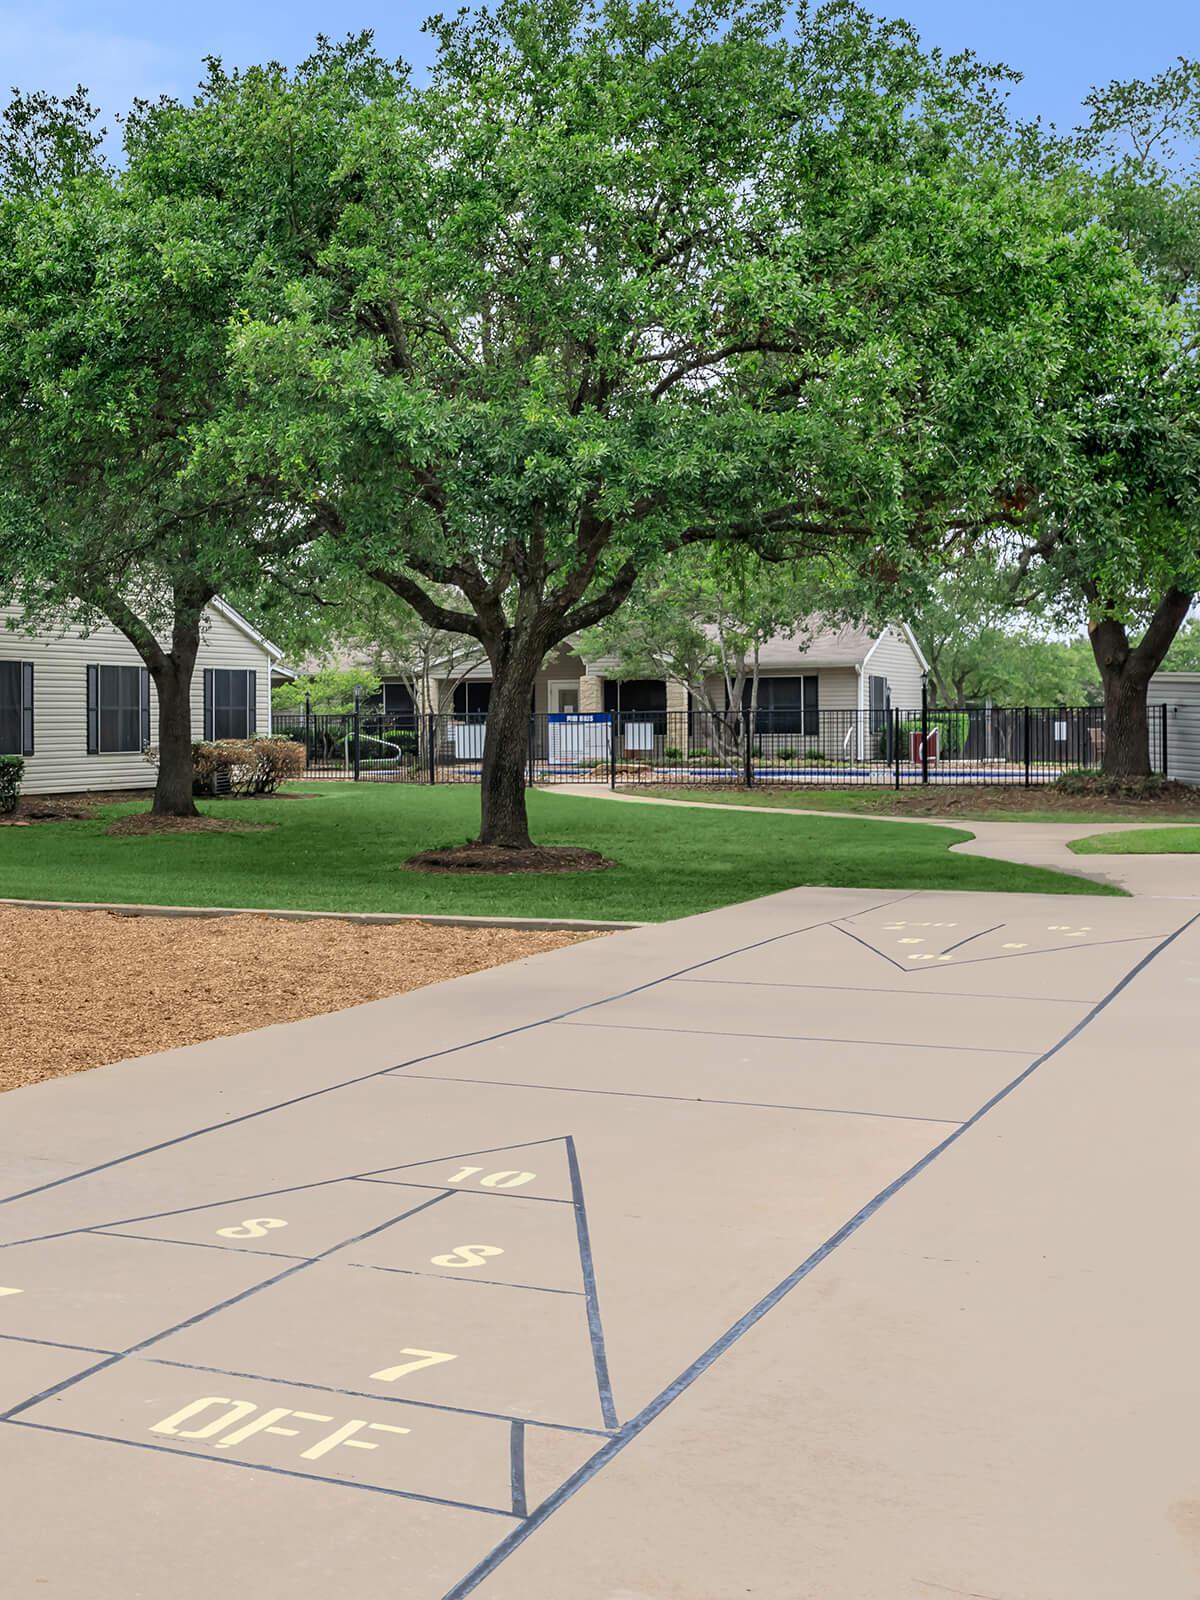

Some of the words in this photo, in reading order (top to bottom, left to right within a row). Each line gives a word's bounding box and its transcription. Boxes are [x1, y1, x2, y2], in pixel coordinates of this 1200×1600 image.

[446, 1165, 538, 1189] 10
[215, 1217, 290, 1239] 8
[430, 1244, 505, 1268] 8
[368, 1347, 459, 1383] 7
[147, 1396, 413, 1461] OFF
